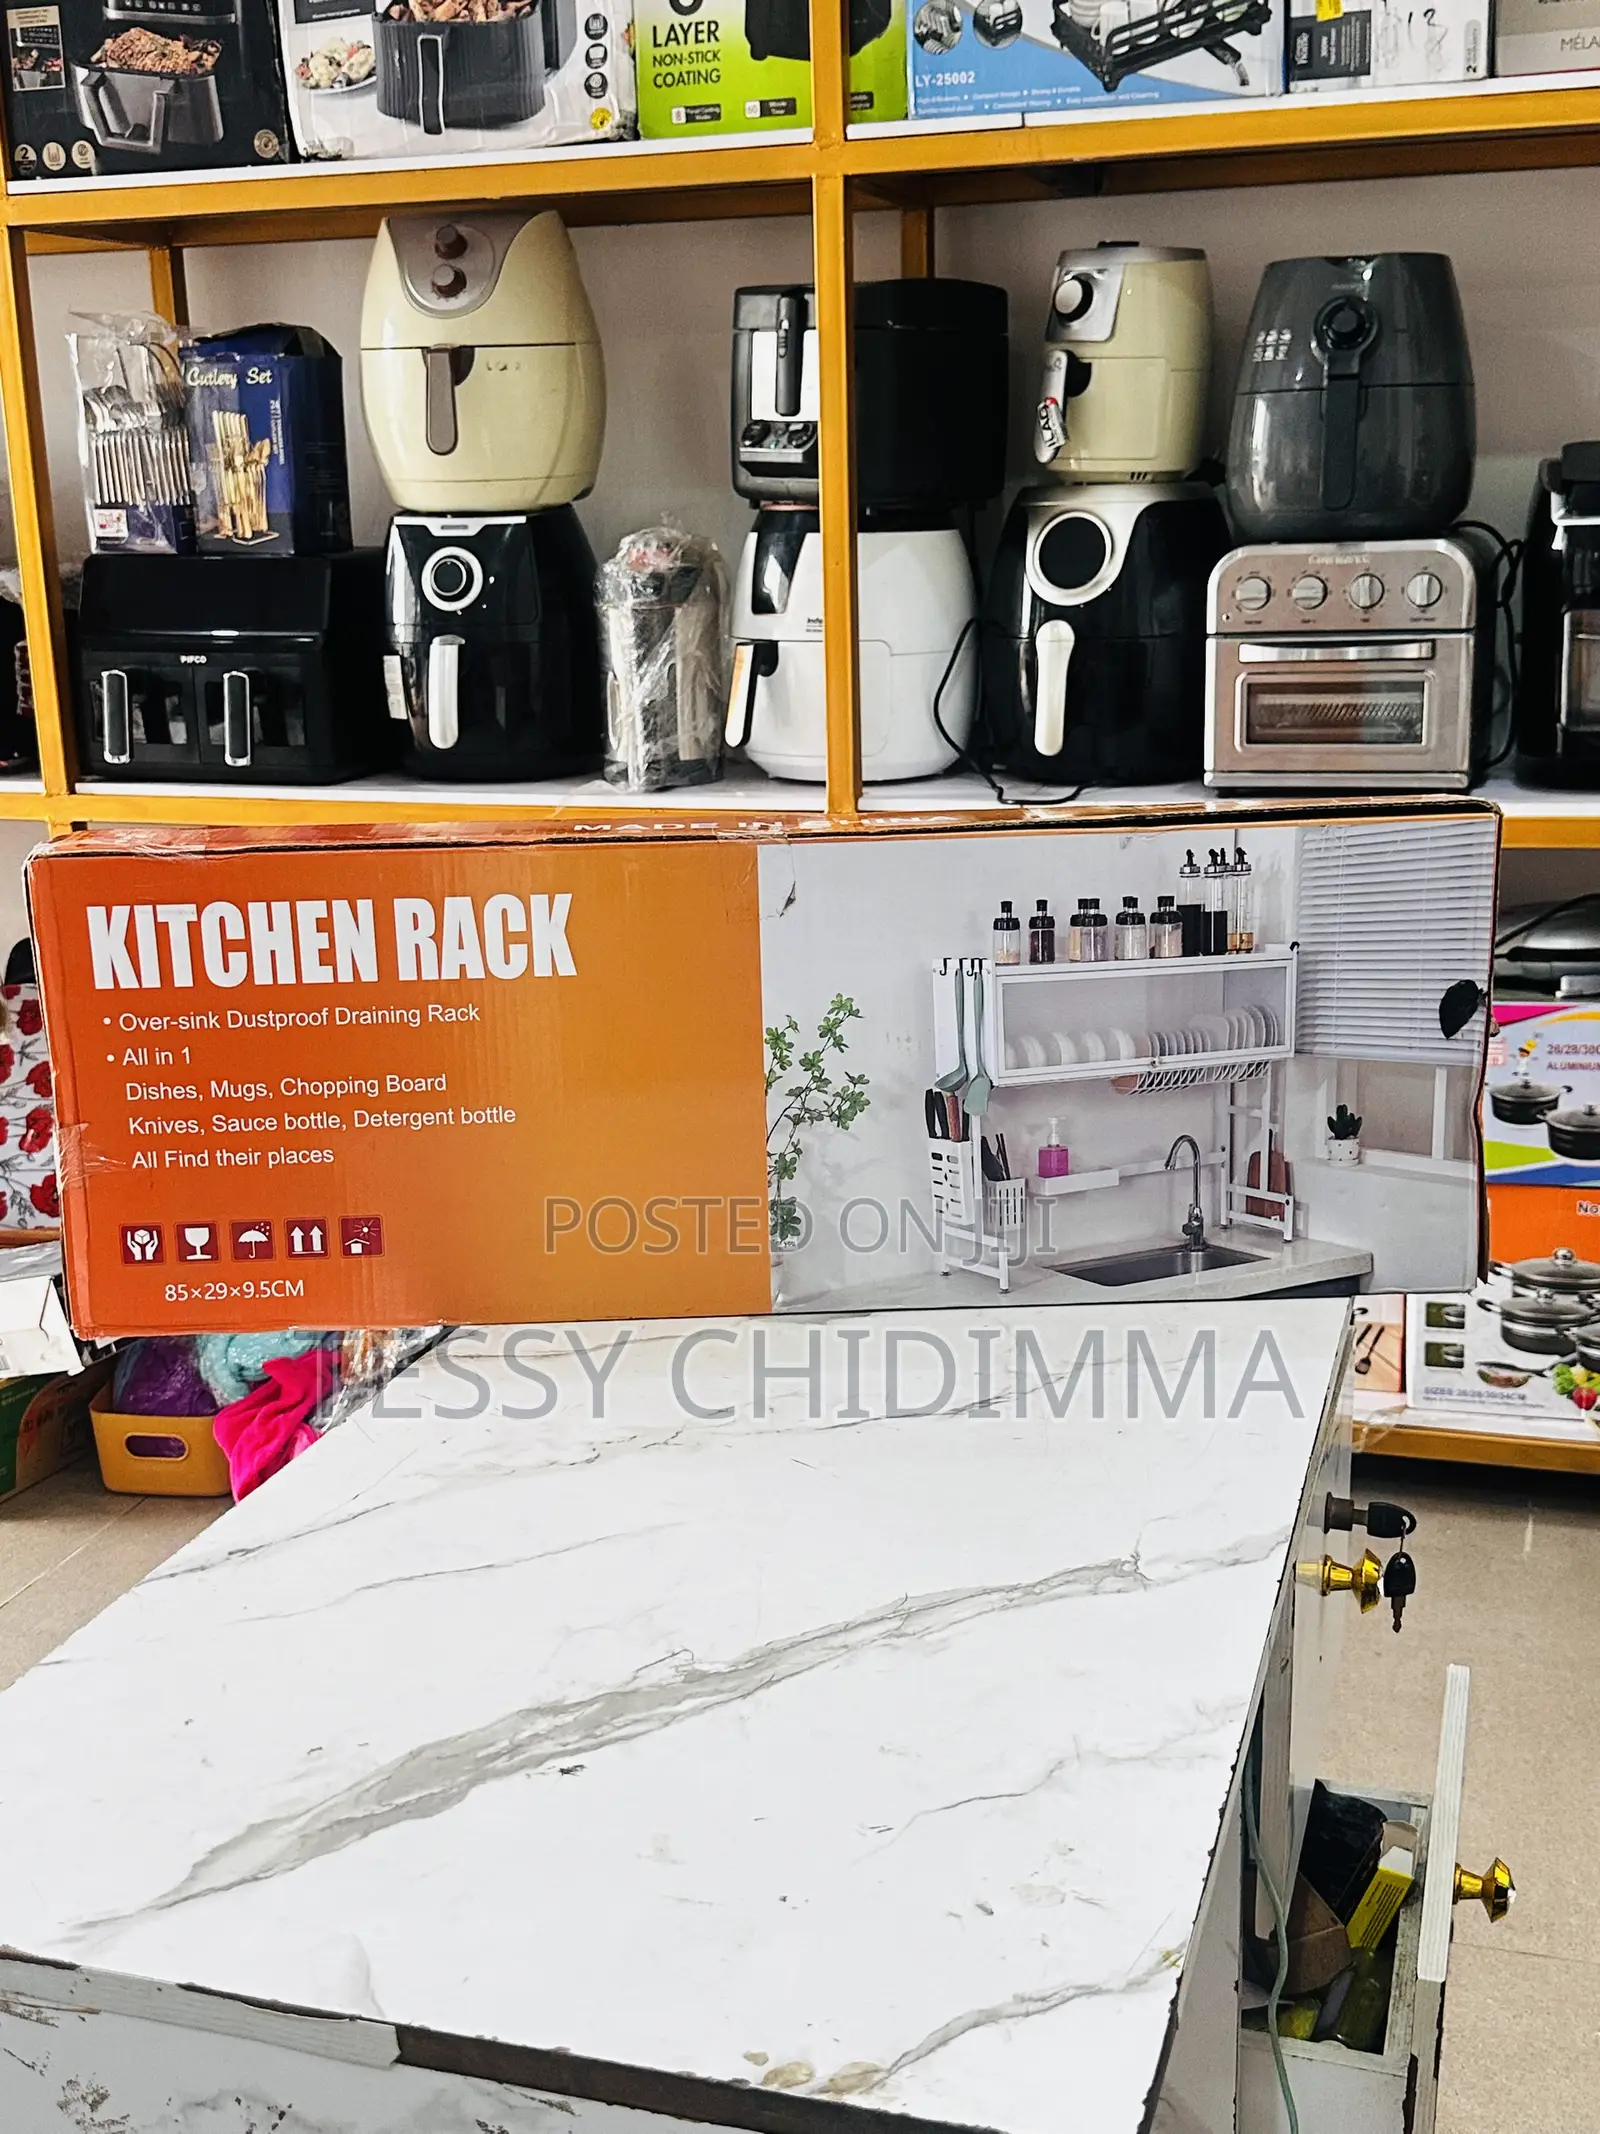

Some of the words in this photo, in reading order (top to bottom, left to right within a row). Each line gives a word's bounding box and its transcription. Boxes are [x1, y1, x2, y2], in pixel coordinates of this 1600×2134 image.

[652, 20, 720, 49] LAYER
[652, 49, 721, 68] NON-STICK
[652, 67, 722, 89] COATING
[915, 71, 976, 88] LY-25002
[19, 146, 29, 160] 2
[186, 366, 238, 389] Cutlery
[245, 366, 274, 385] Set
[180, 655, 208, 664] PIFCO
[573, 821, 718, 832] MADE
[738, 820, 784, 831] IN
[798, 815, 962, 829] CHINA
[86, 898, 379, 991] KITCHEN
[393, 893, 578, 982] RACK
[119, 1009, 221, 1032] Over-sink
[227, 1007, 330, 1031] Dustproof
[335, 1005, 422, 1028] Draining
[428, 1003, 481, 1023] Rack
[122, 1048, 149, 1066] All
[155, 1047, 173, 1065] in
[181, 1047, 192, 1065] 1
[126, 1081, 203, 1102] Dishes,
[210, 1079, 274, 1102] Mugs,
[280, 1075, 379, 1099] Chopping
[386, 1073, 448, 1094] Board
[129, 1115, 205, 1137] Knives,
[212, 1114, 277, 1133] Sauce
[284, 1111, 347, 1132] bottle,
[353, 1108, 455, 1130] Detergent
[461, 1106, 517, 1125] bottle
[132, 1150, 158, 1170] All
[164, 1148, 210, 1169] Find
[215, 1147, 262, 1167] their
[268, 1145, 335, 1169] places
